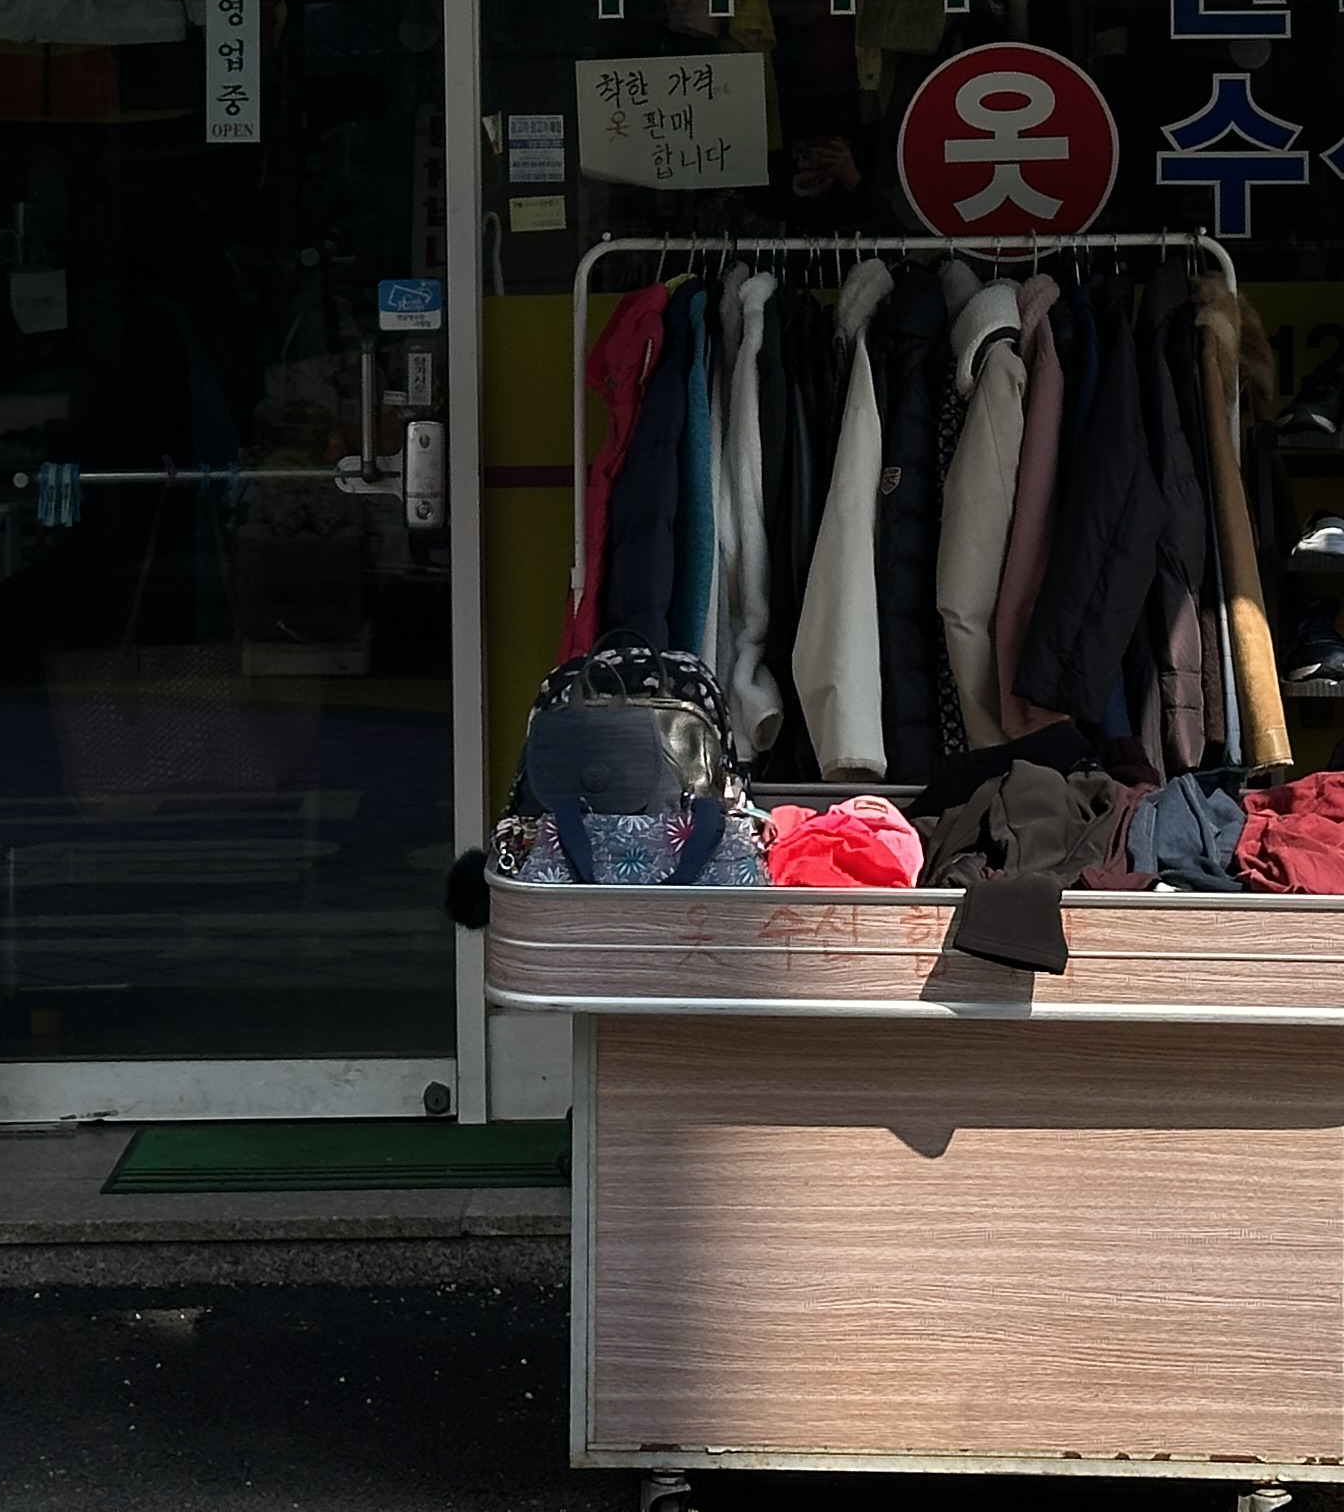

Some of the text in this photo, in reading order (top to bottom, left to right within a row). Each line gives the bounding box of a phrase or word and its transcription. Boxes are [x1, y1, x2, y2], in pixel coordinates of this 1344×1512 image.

[595, 63, 715, 109] 착한 가격
[212, 122, 254, 138] OPEN
[606, 103, 694, 143] 옷 판매
[651, 137, 732, 179] 합니다
[944, 70, 1070, 223] 옷
